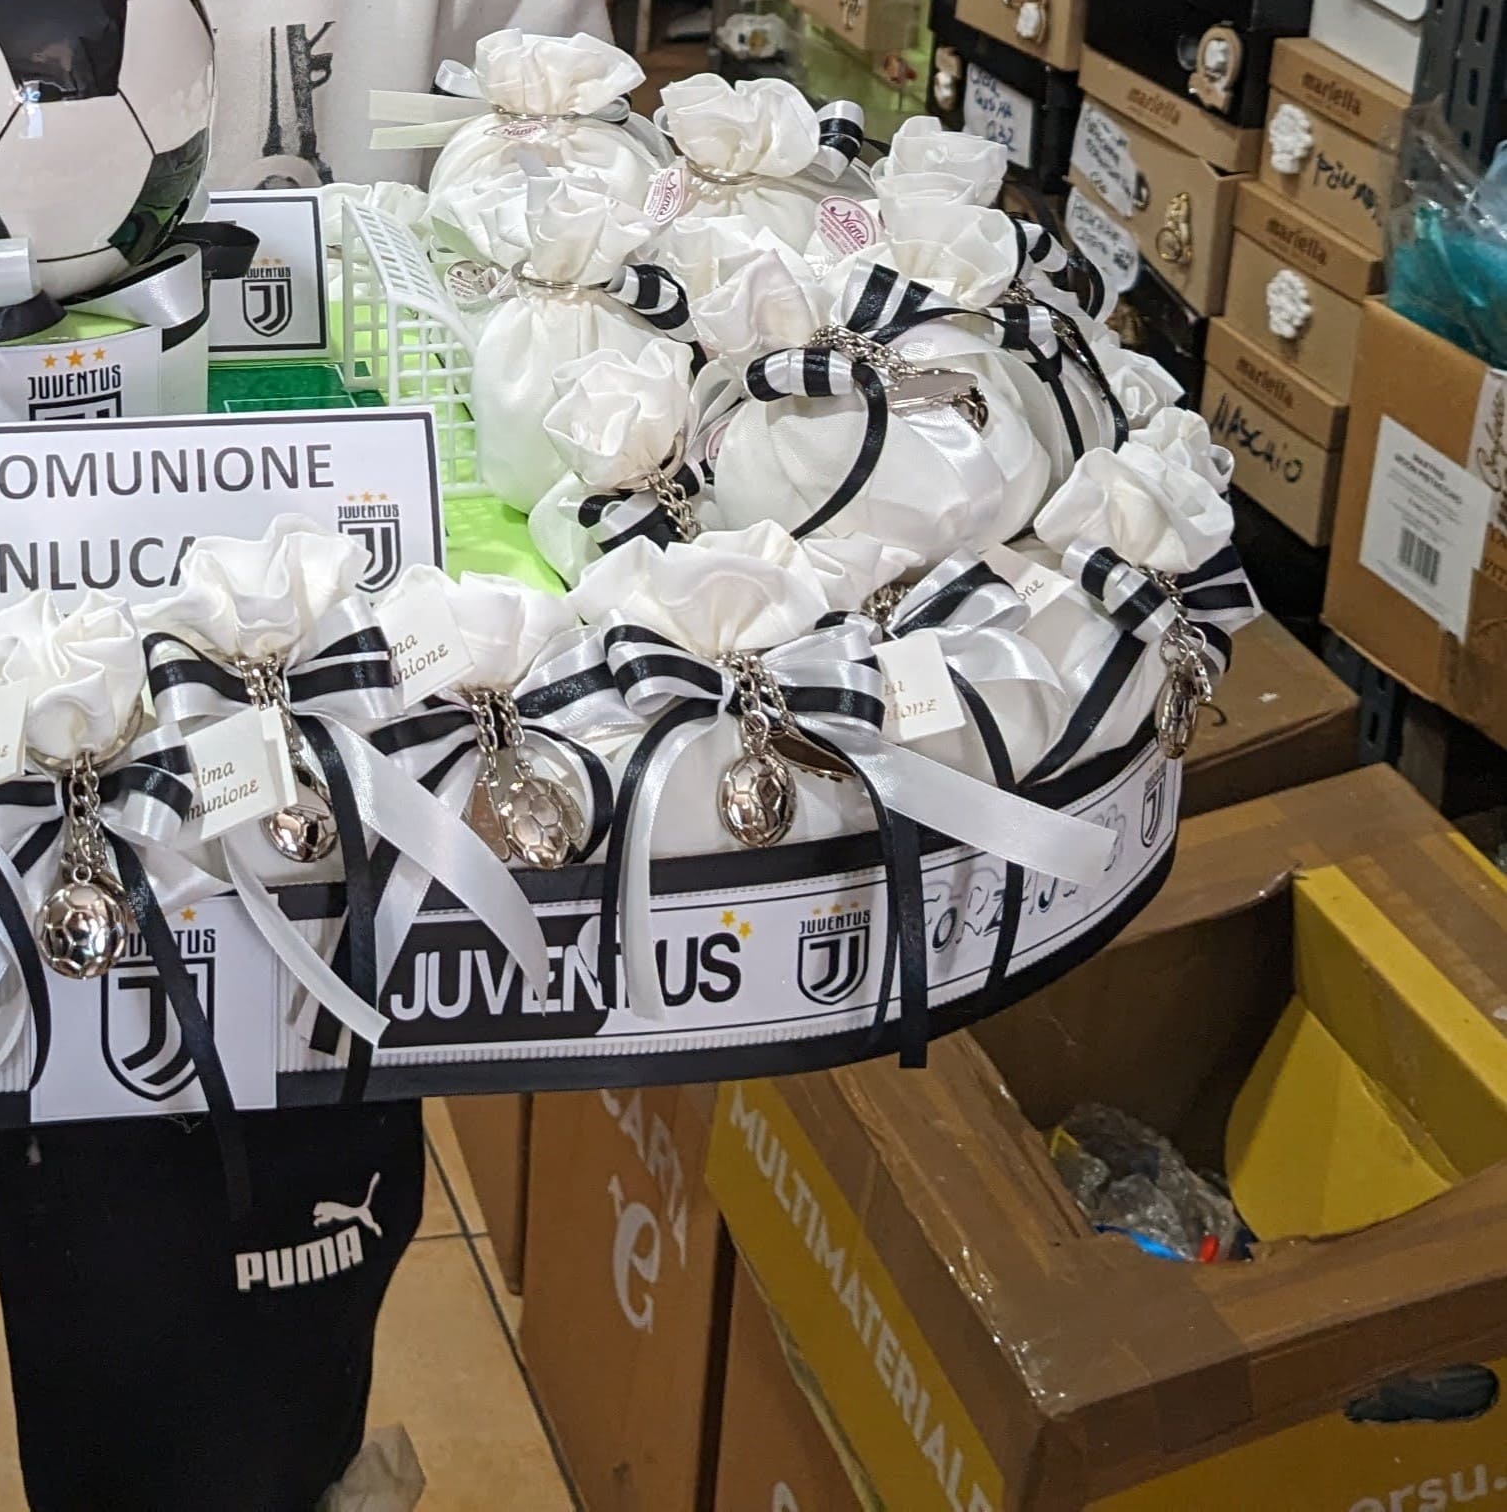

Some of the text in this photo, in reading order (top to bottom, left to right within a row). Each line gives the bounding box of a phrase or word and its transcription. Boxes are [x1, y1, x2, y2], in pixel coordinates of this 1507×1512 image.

[1301, 72, 1362, 117] mariella
[1265, 218, 1328, 266] mariella
[247, 267, 291, 278] UVENTUS
[27, 364, 122, 400] JUVENTUS
[1236, 356, 1294, 409] mariella
[337, 504, 400, 519] JUVENTUS
[393, 643, 449, 686] unione
[195, 761, 235, 788] rima
[184, 779, 259, 823] munione
[799, 908, 871, 935] JUVENTUS
[390, 932, 741, 1021] JUVENUS
[236, 1226, 363, 1291] PUMA
